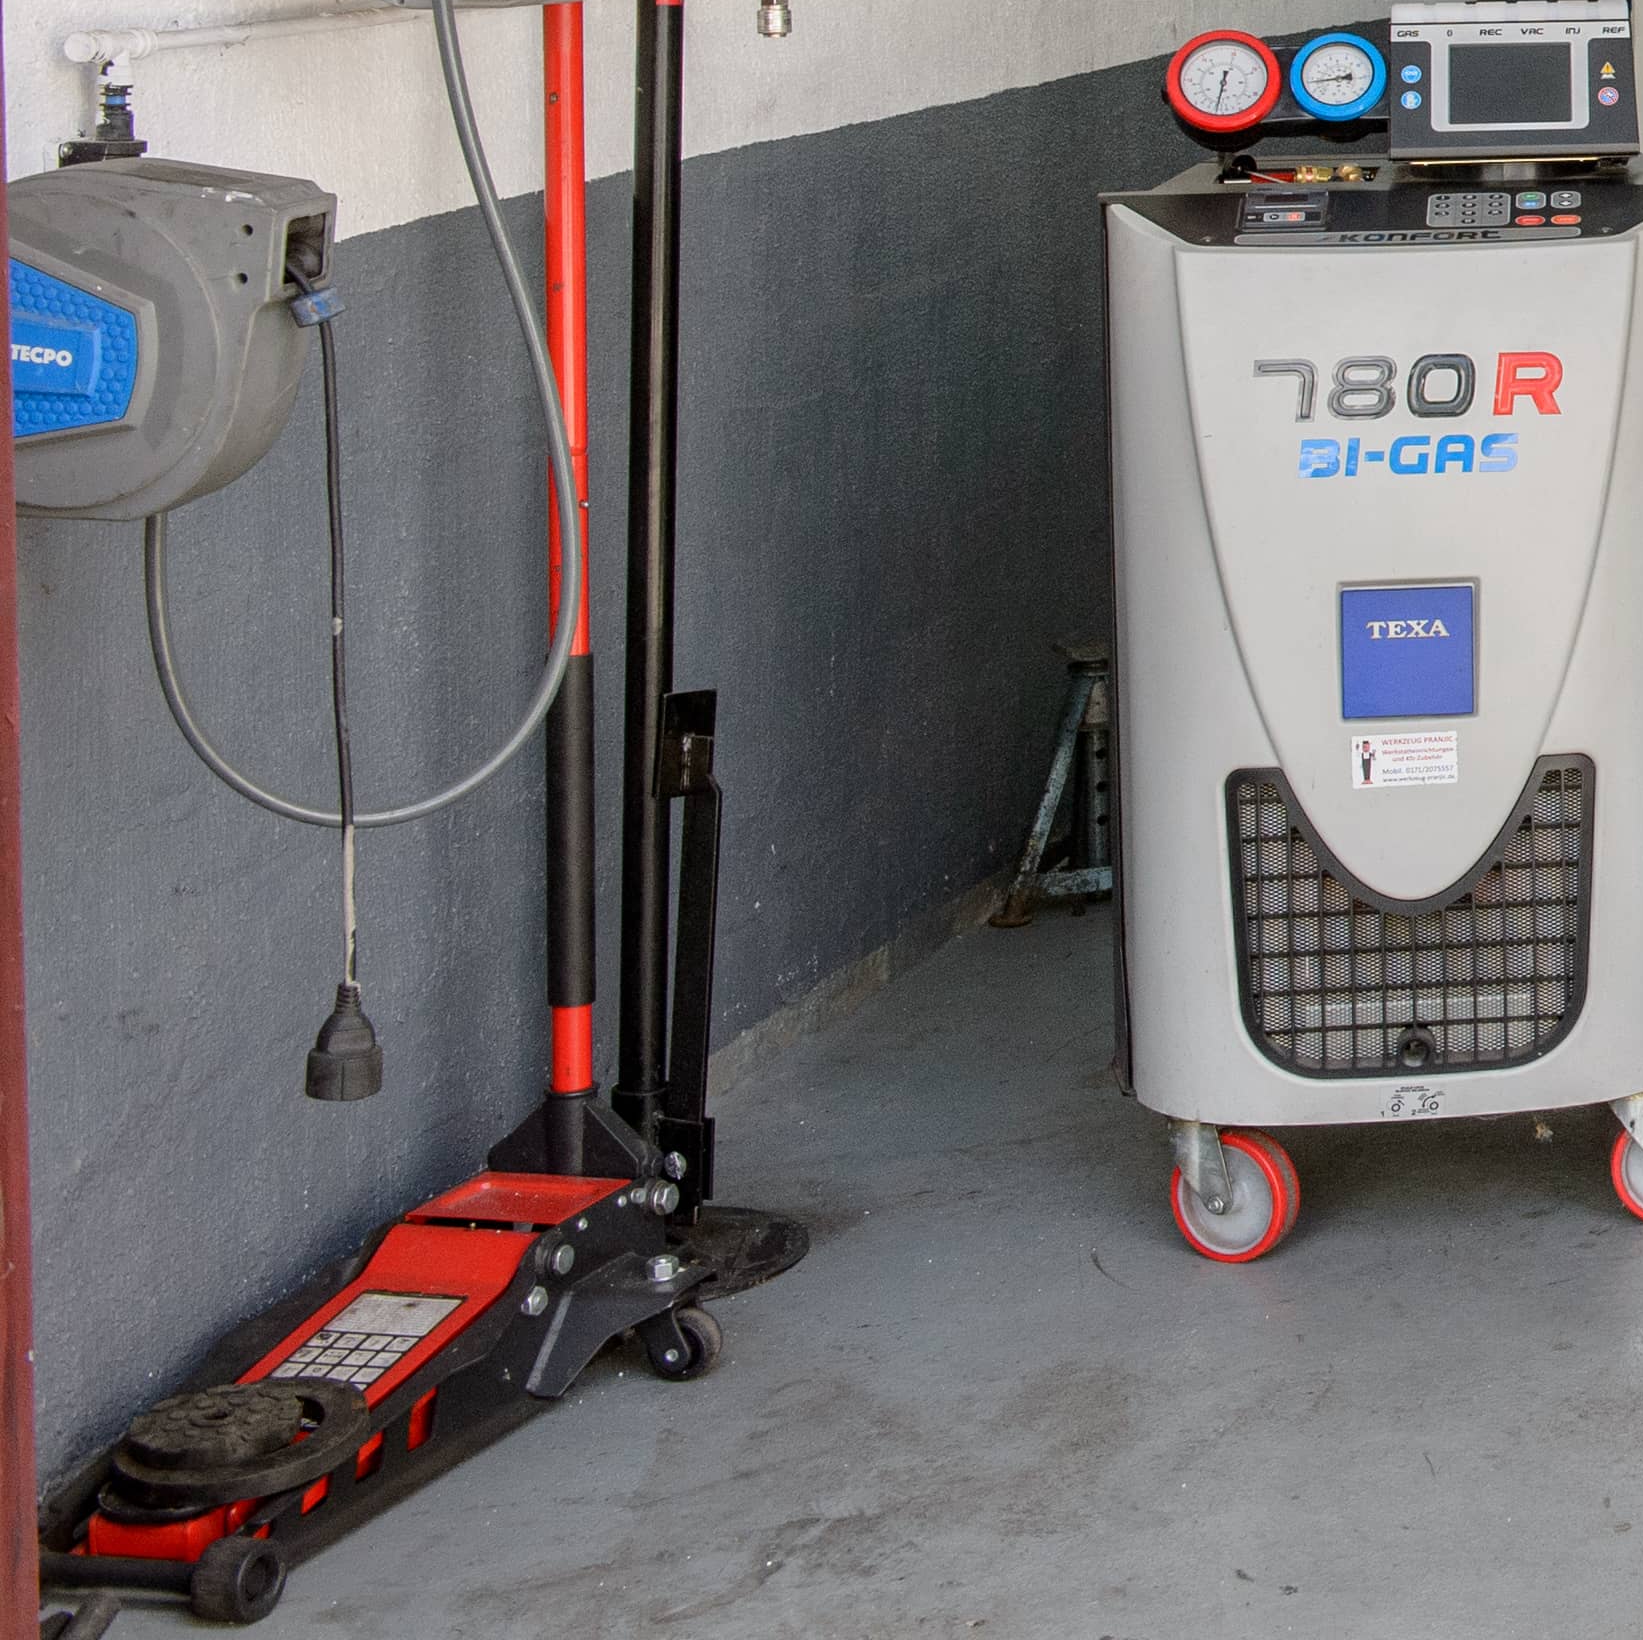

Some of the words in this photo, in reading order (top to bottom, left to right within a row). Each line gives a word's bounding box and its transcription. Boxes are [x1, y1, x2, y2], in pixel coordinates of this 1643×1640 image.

[1479, 28, 1503, 37] REC
[1520, 27, 1544, 35] VAC
[1565, 27, 1581, 35] INJ
[1602, 26, 1625, 34] REF
[1297, 433, 1520, 479] BI-GAS
[1366, 619, 1450, 640] TEXA
[1381, 737, 1422, 746] WERKZEUG
